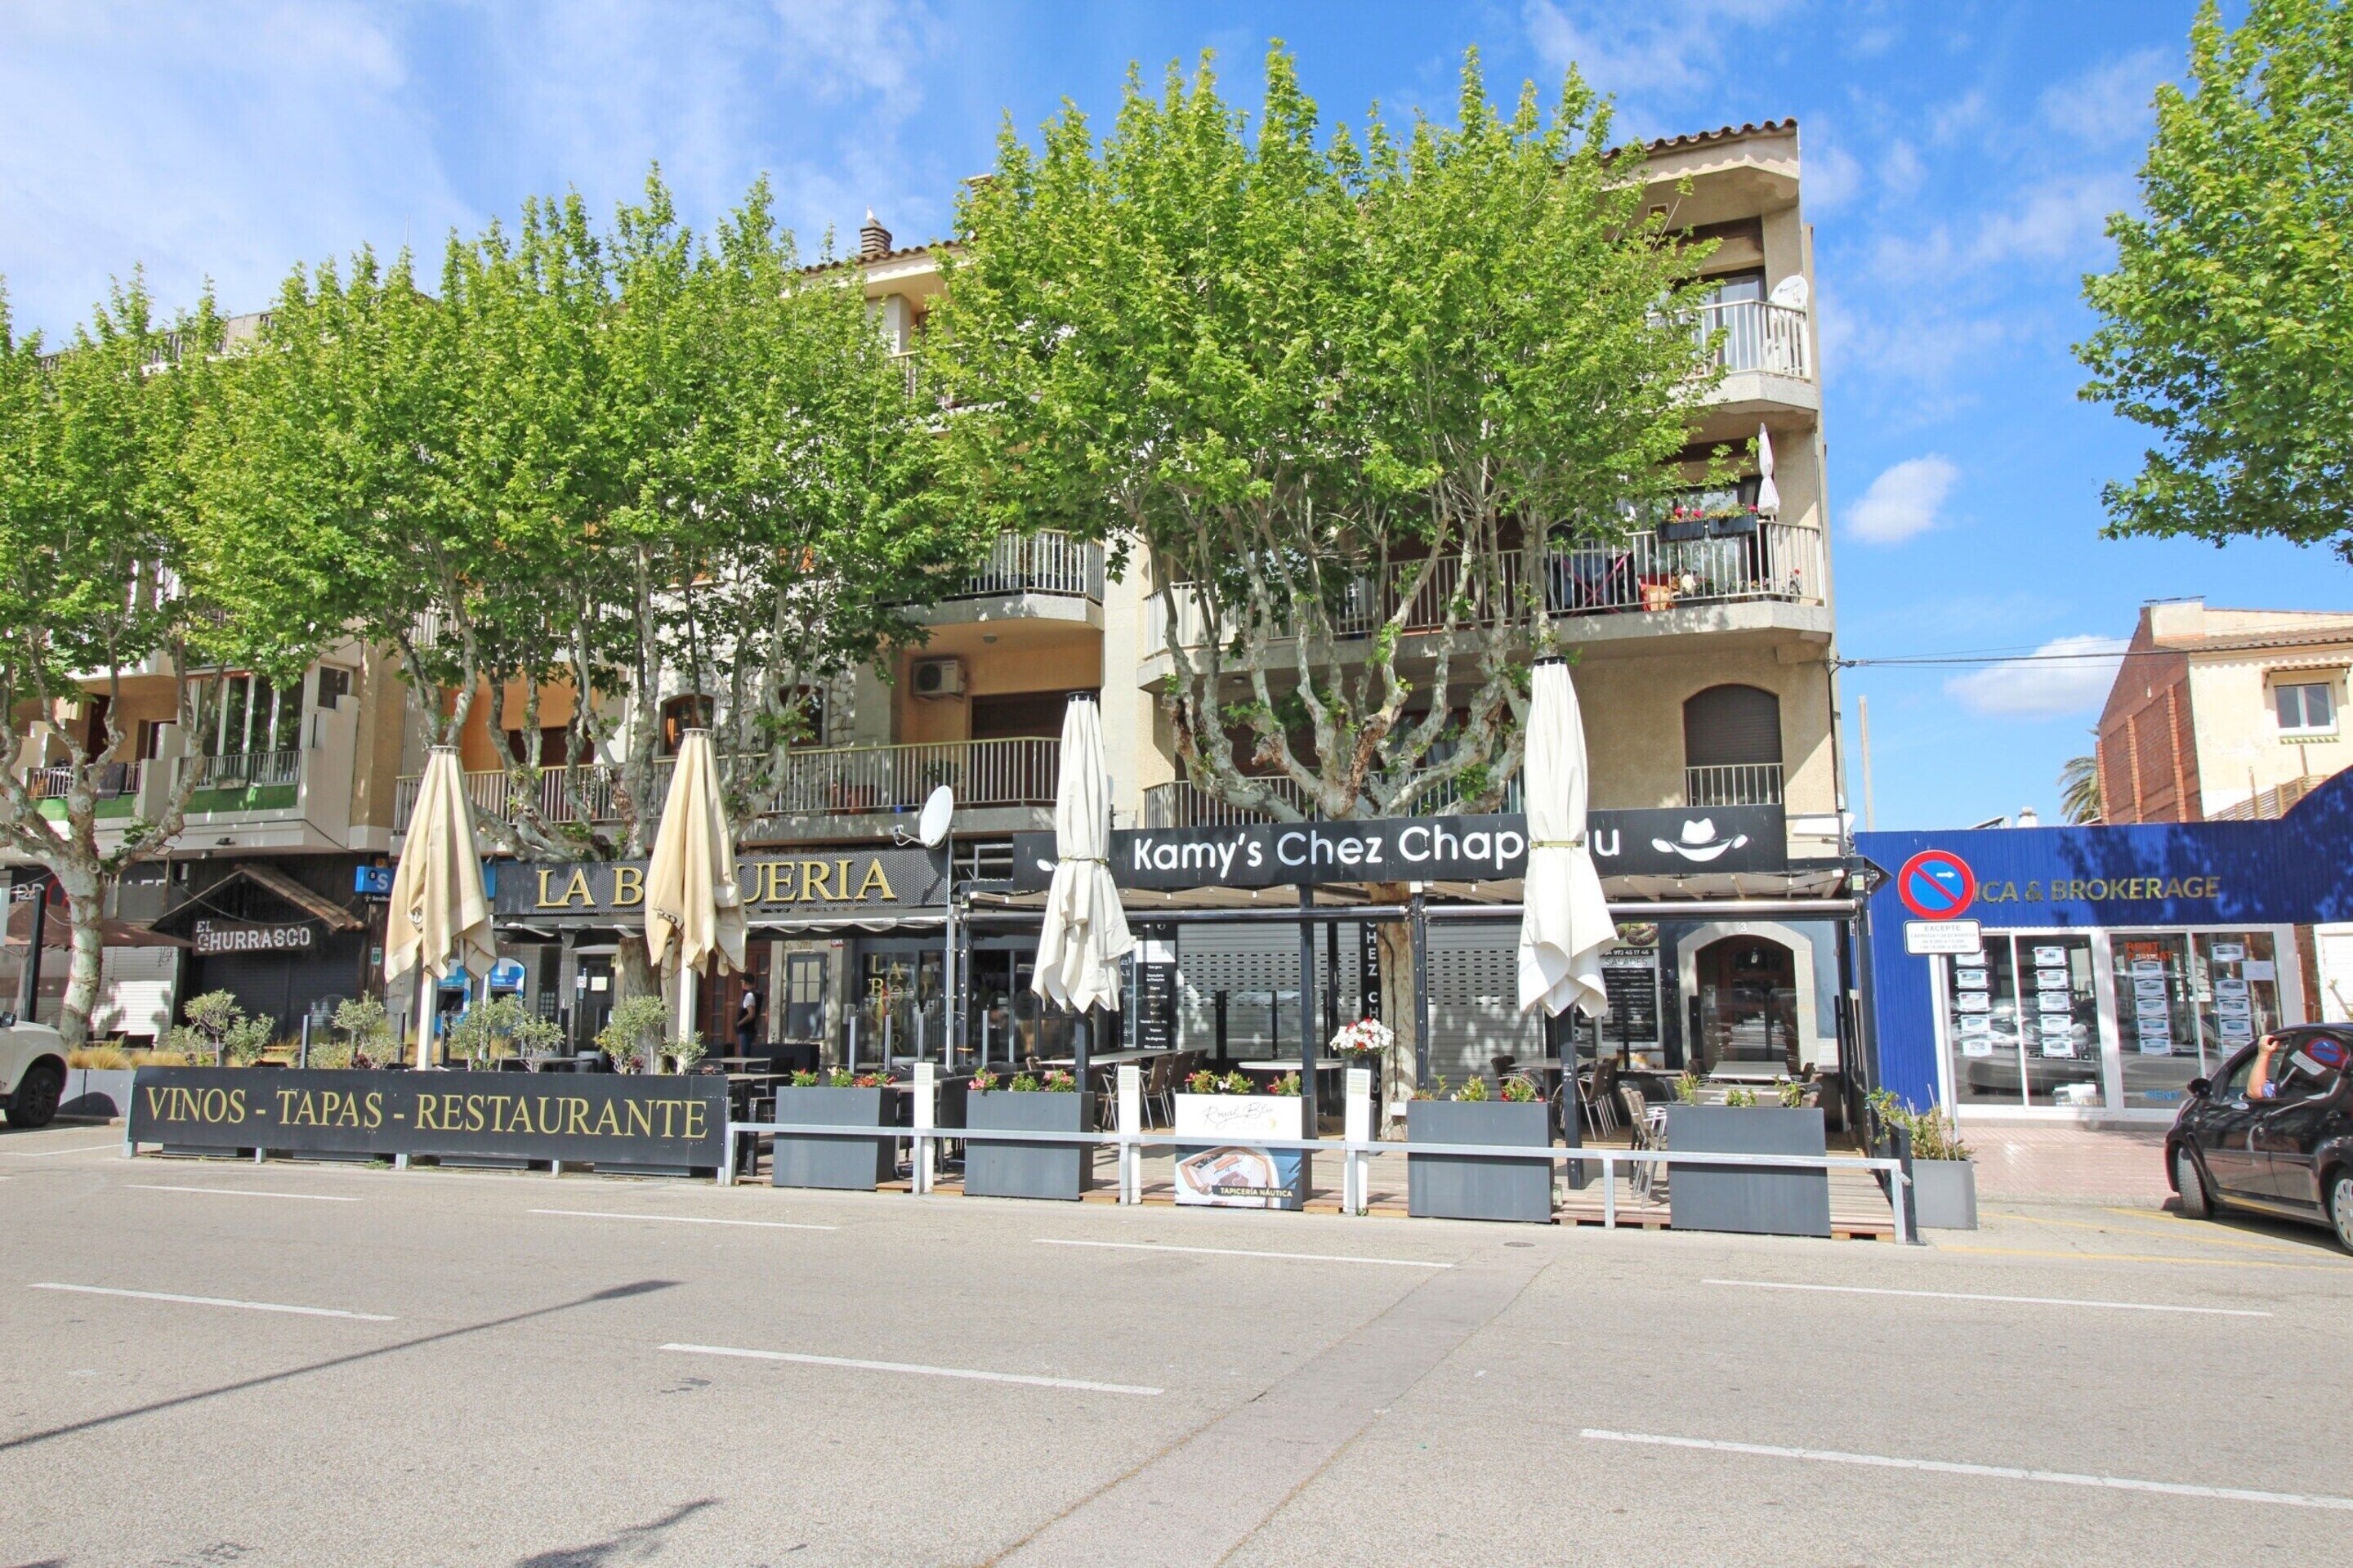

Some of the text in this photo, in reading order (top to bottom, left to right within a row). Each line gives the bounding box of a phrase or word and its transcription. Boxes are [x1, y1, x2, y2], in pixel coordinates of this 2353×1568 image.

[1134, 824, 1620, 878] Kamy's Chez Chapu
[535, 858, 898, 907] LA BUERIA
[2025, 880, 2043, 902] &
[2051, 876, 2221, 902] BROKERAGE
[196, 920, 213, 932] EL
[146, 1087, 246, 1124] VINOS
[276, 1091, 383, 1128] TAPAS
[414, 1093, 708, 1139] RESTAURANTE
[1221, 1186, 1293, 1197] TAPICERÍA NÁUTICA
